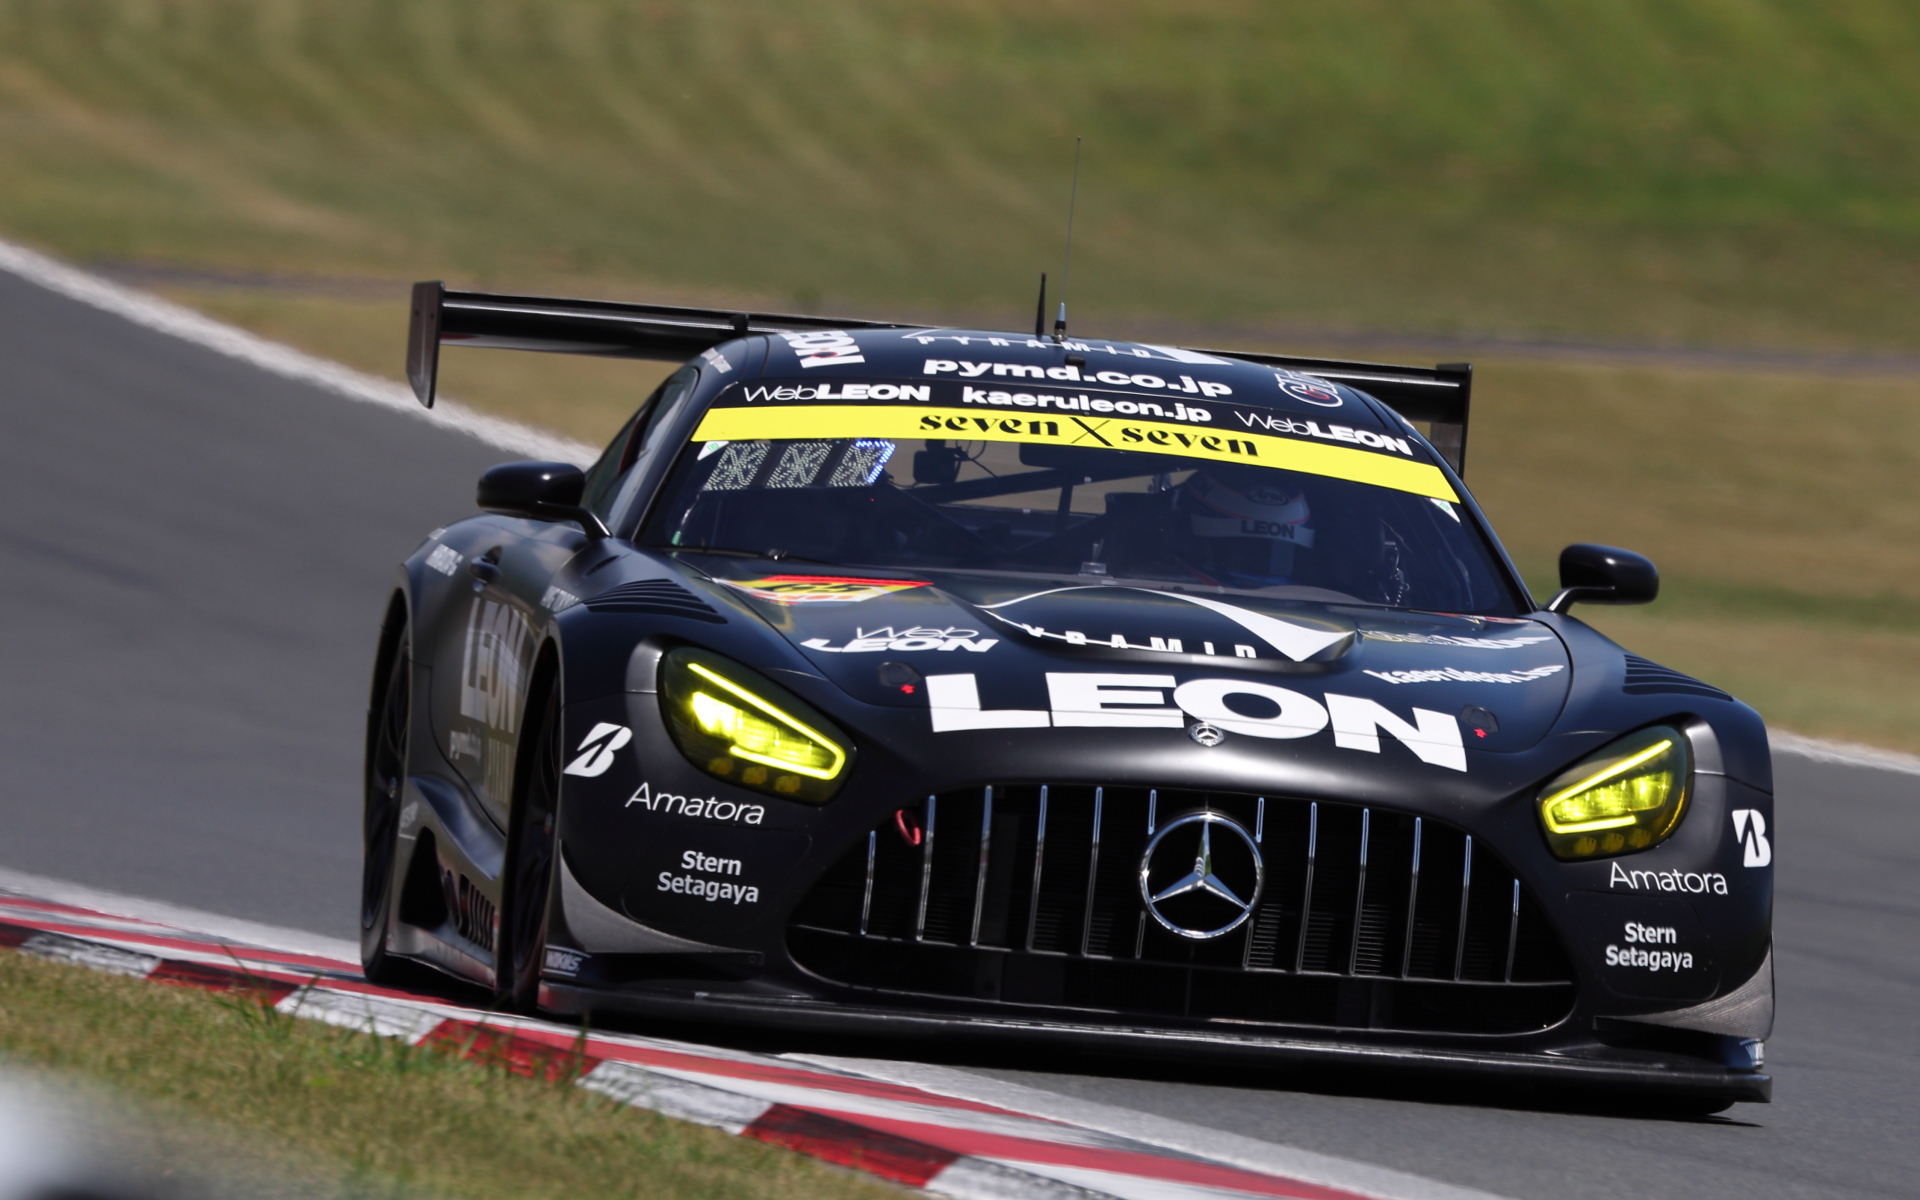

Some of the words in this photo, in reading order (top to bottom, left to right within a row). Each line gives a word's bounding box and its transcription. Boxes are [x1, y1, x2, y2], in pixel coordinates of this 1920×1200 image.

[922, 358, 1233, 397] pymd.co.jp
[962, 385, 1213, 422] kaeruleon.jp
[919, 414, 1061, 437] seven
[1121, 427, 1260, 458] seven
[1240, 519, 1295, 540] LEON
[800, 637, 1000, 653] LEON
[856, 625, 980, 641] Web
[925, 672, 1468, 773] LEON
[625, 781, 765, 825] Amatora
[680, 849, 742, 876] Stern
[1609, 861, 1728, 895] Amatora
[657, 871, 759, 905] Setagaya
[1624, 921, 1677, 944] Stern
[1605, 944, 1693, 973] Setagaya
